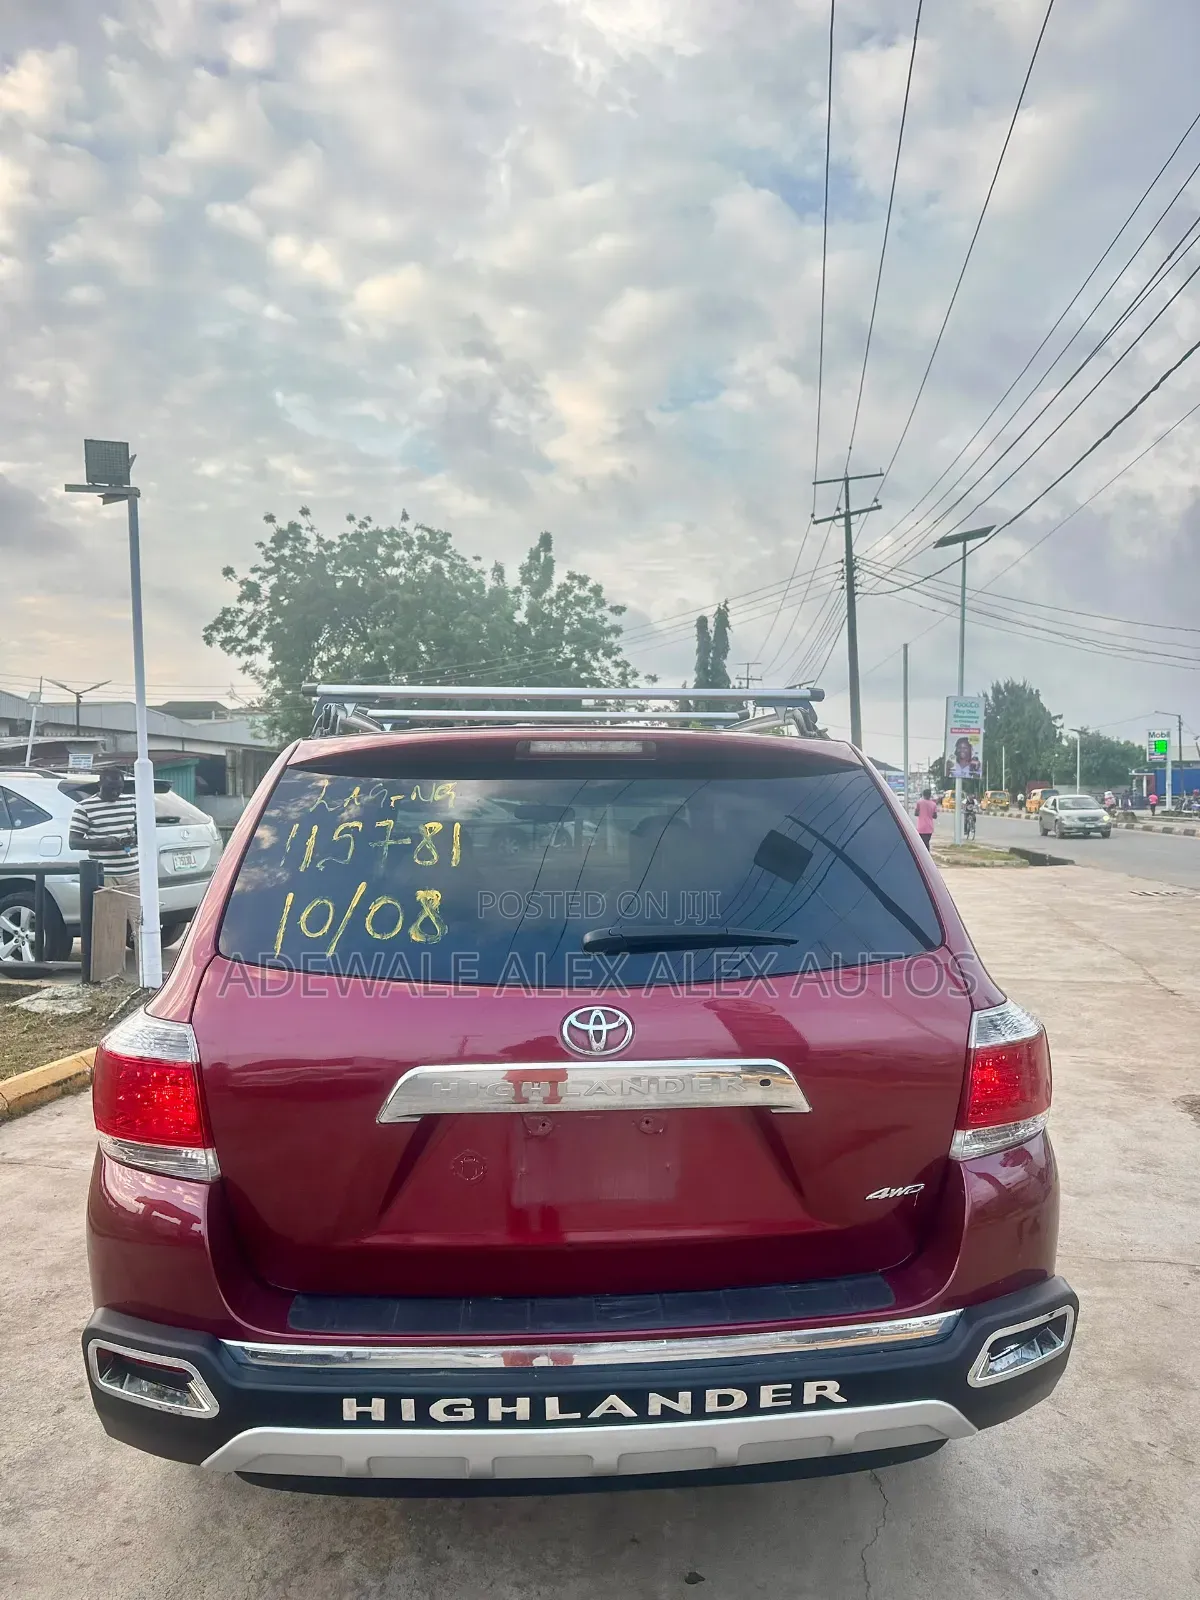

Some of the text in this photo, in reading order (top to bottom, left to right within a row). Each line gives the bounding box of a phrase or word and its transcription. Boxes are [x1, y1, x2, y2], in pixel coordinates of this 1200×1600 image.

[1148, 731, 1171, 739] Mobil
[274, 882, 448, 959] 10/08
[430, 1075, 747, 1101] HIGHLANDER
[865, 1183, 926, 1200] 4WD
[341, 1379, 848, 1424] HIGHLANDER
